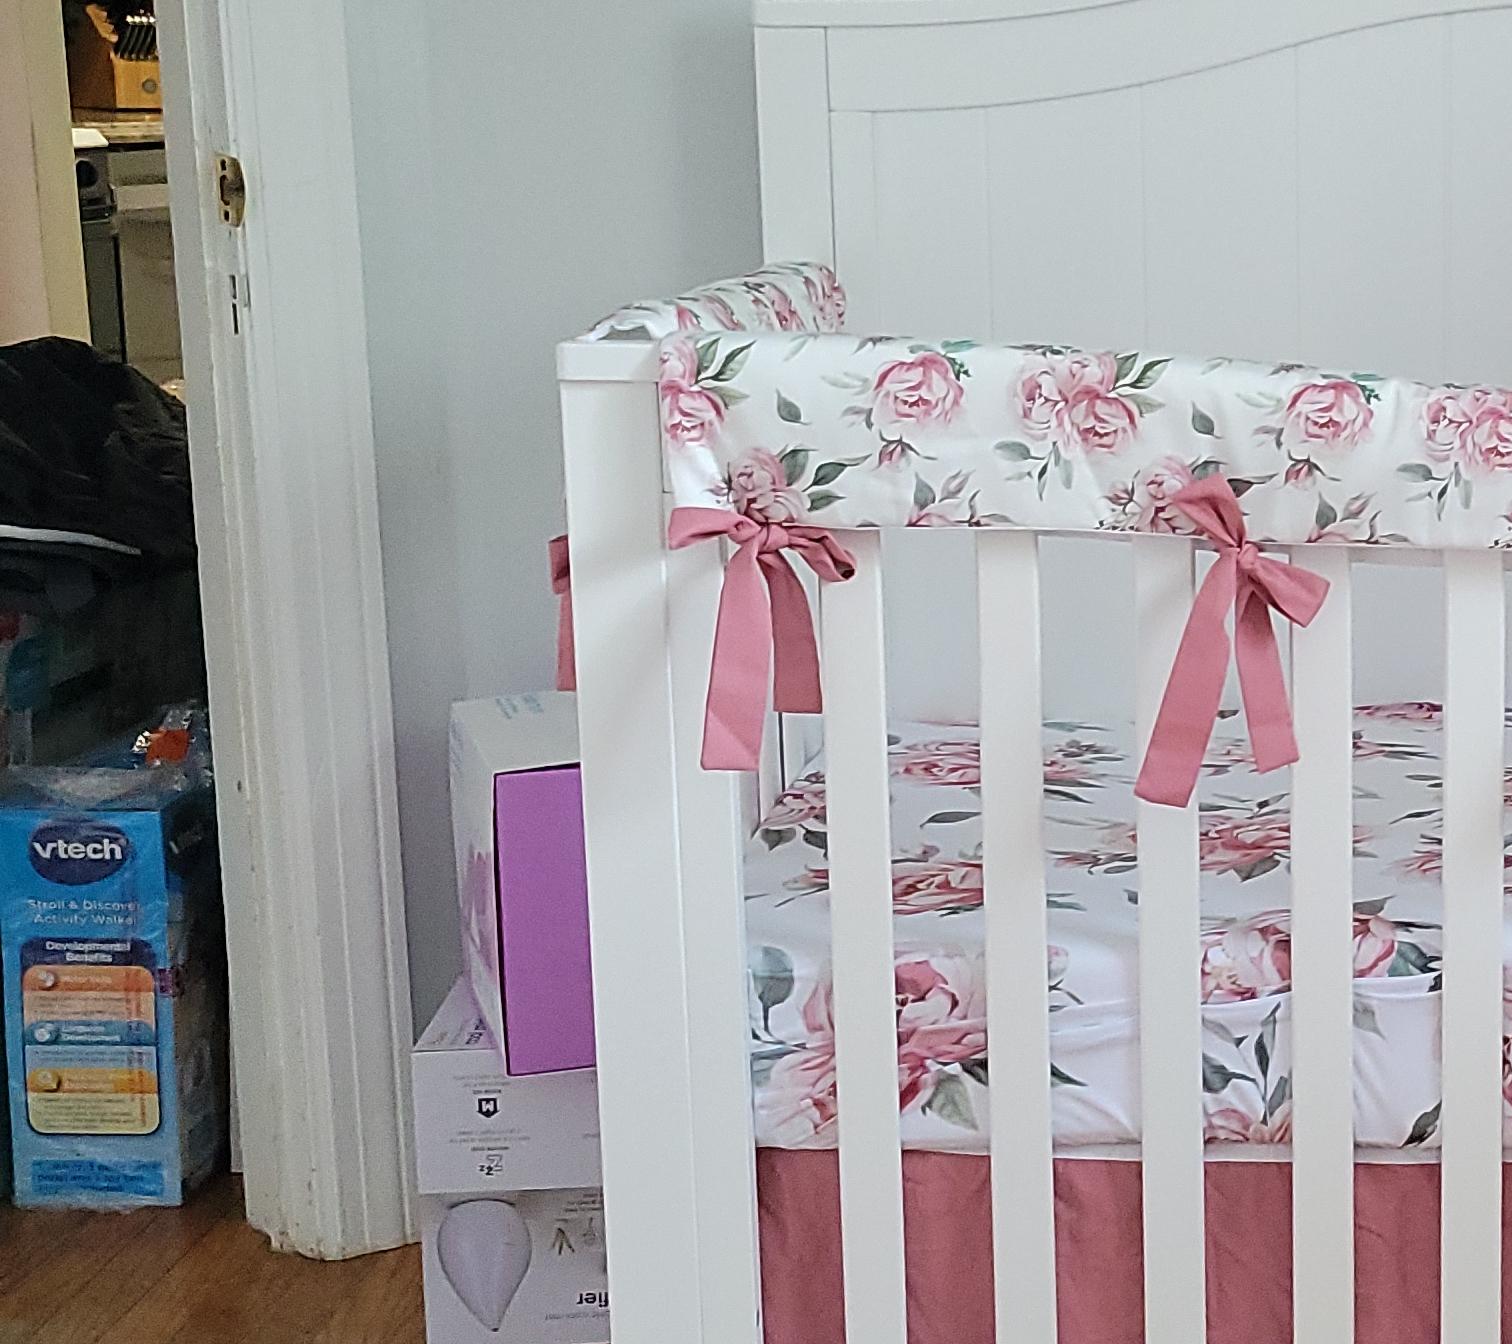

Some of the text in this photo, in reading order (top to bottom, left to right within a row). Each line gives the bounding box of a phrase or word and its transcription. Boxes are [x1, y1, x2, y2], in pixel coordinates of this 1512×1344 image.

[33, 839, 123, 860] vtech
[68, 900, 79, 910] &
[33, 914, 88, 926] Activity
